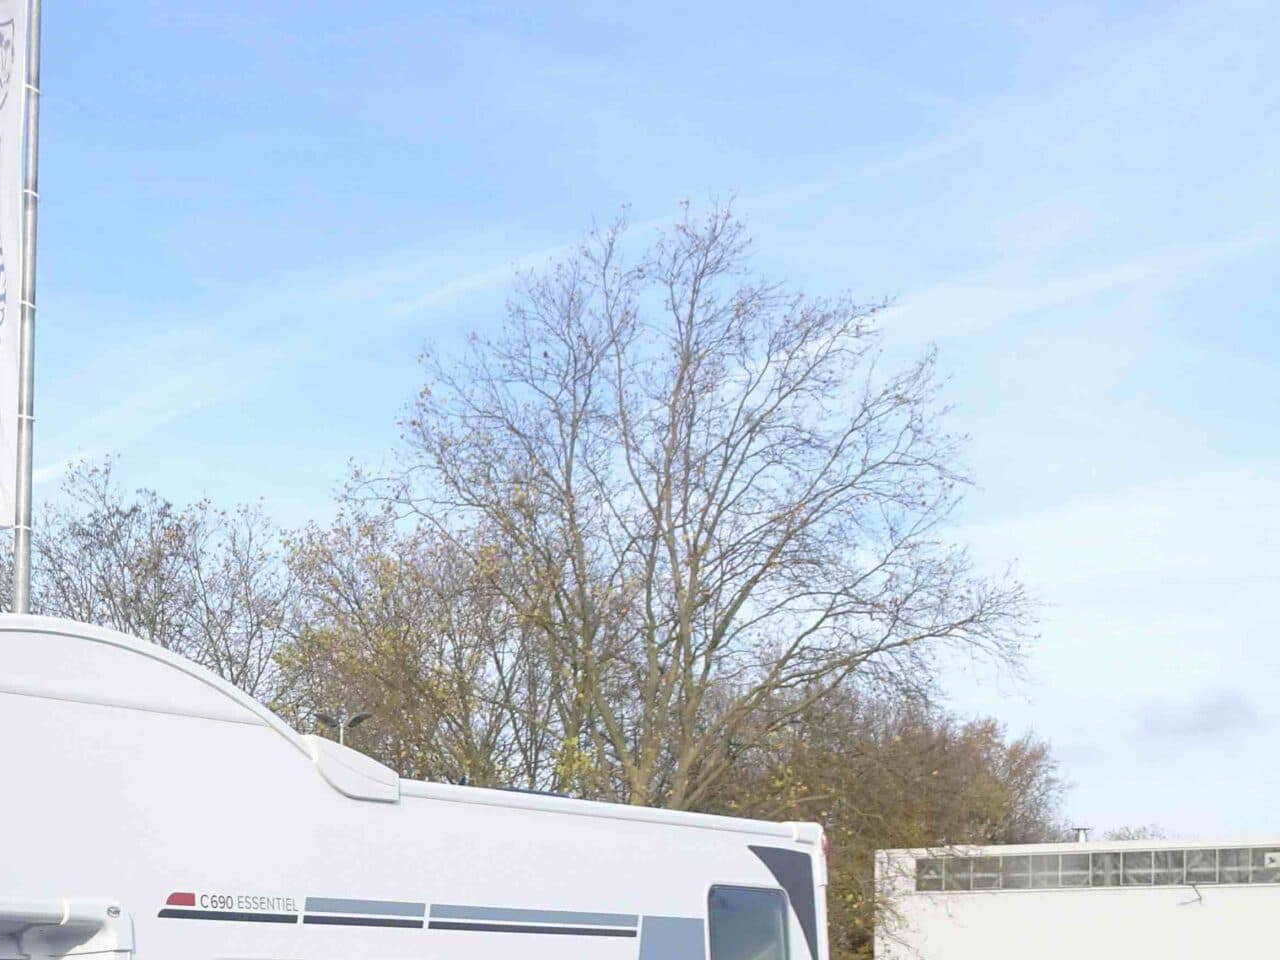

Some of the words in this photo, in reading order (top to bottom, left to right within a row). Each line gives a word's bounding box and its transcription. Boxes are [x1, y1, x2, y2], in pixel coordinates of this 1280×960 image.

[200, 894, 209, 909] C
[210, 895, 234, 910] 690
[237, 895, 299, 912] ESSENTIEL
